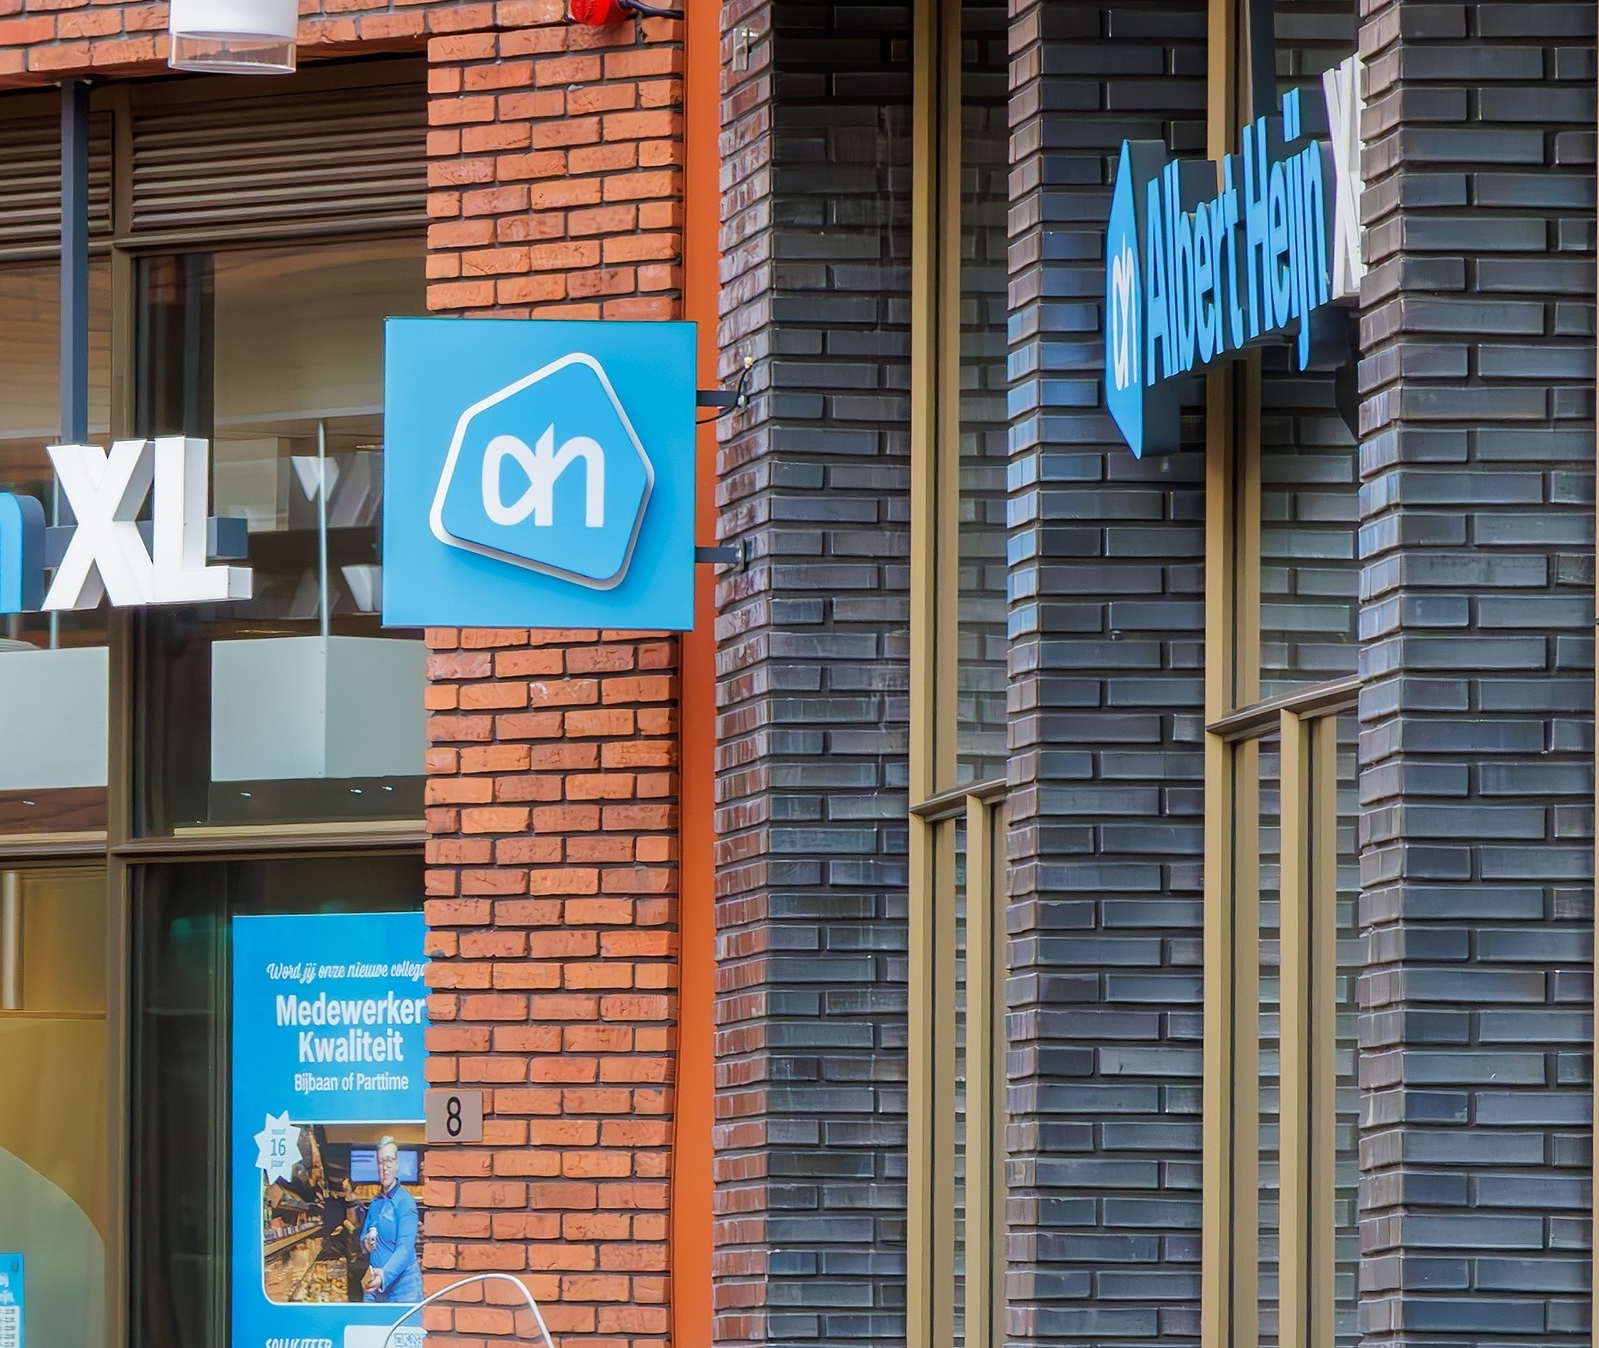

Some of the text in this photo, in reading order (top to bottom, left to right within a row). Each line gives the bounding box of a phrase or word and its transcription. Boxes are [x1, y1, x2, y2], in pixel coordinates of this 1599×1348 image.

[1147, 153, 1244, 387] Albert
[1242, 87, 1328, 371] Heijn
[41, 436, 248, 611] XL
[266, 962, 300, 979] Word
[318, 965, 345, 977] onze
[346, 962, 388, 978] nieuwe
[276, 991, 427, 1026] Medewerker
[299, 1028, 404, 1062] Kwaliteit
[294, 1072, 409, 1094] Bijbaan of Parttime
[447, 1097, 461, 1136] 8
[270, 1138, 286, 1156] 16
